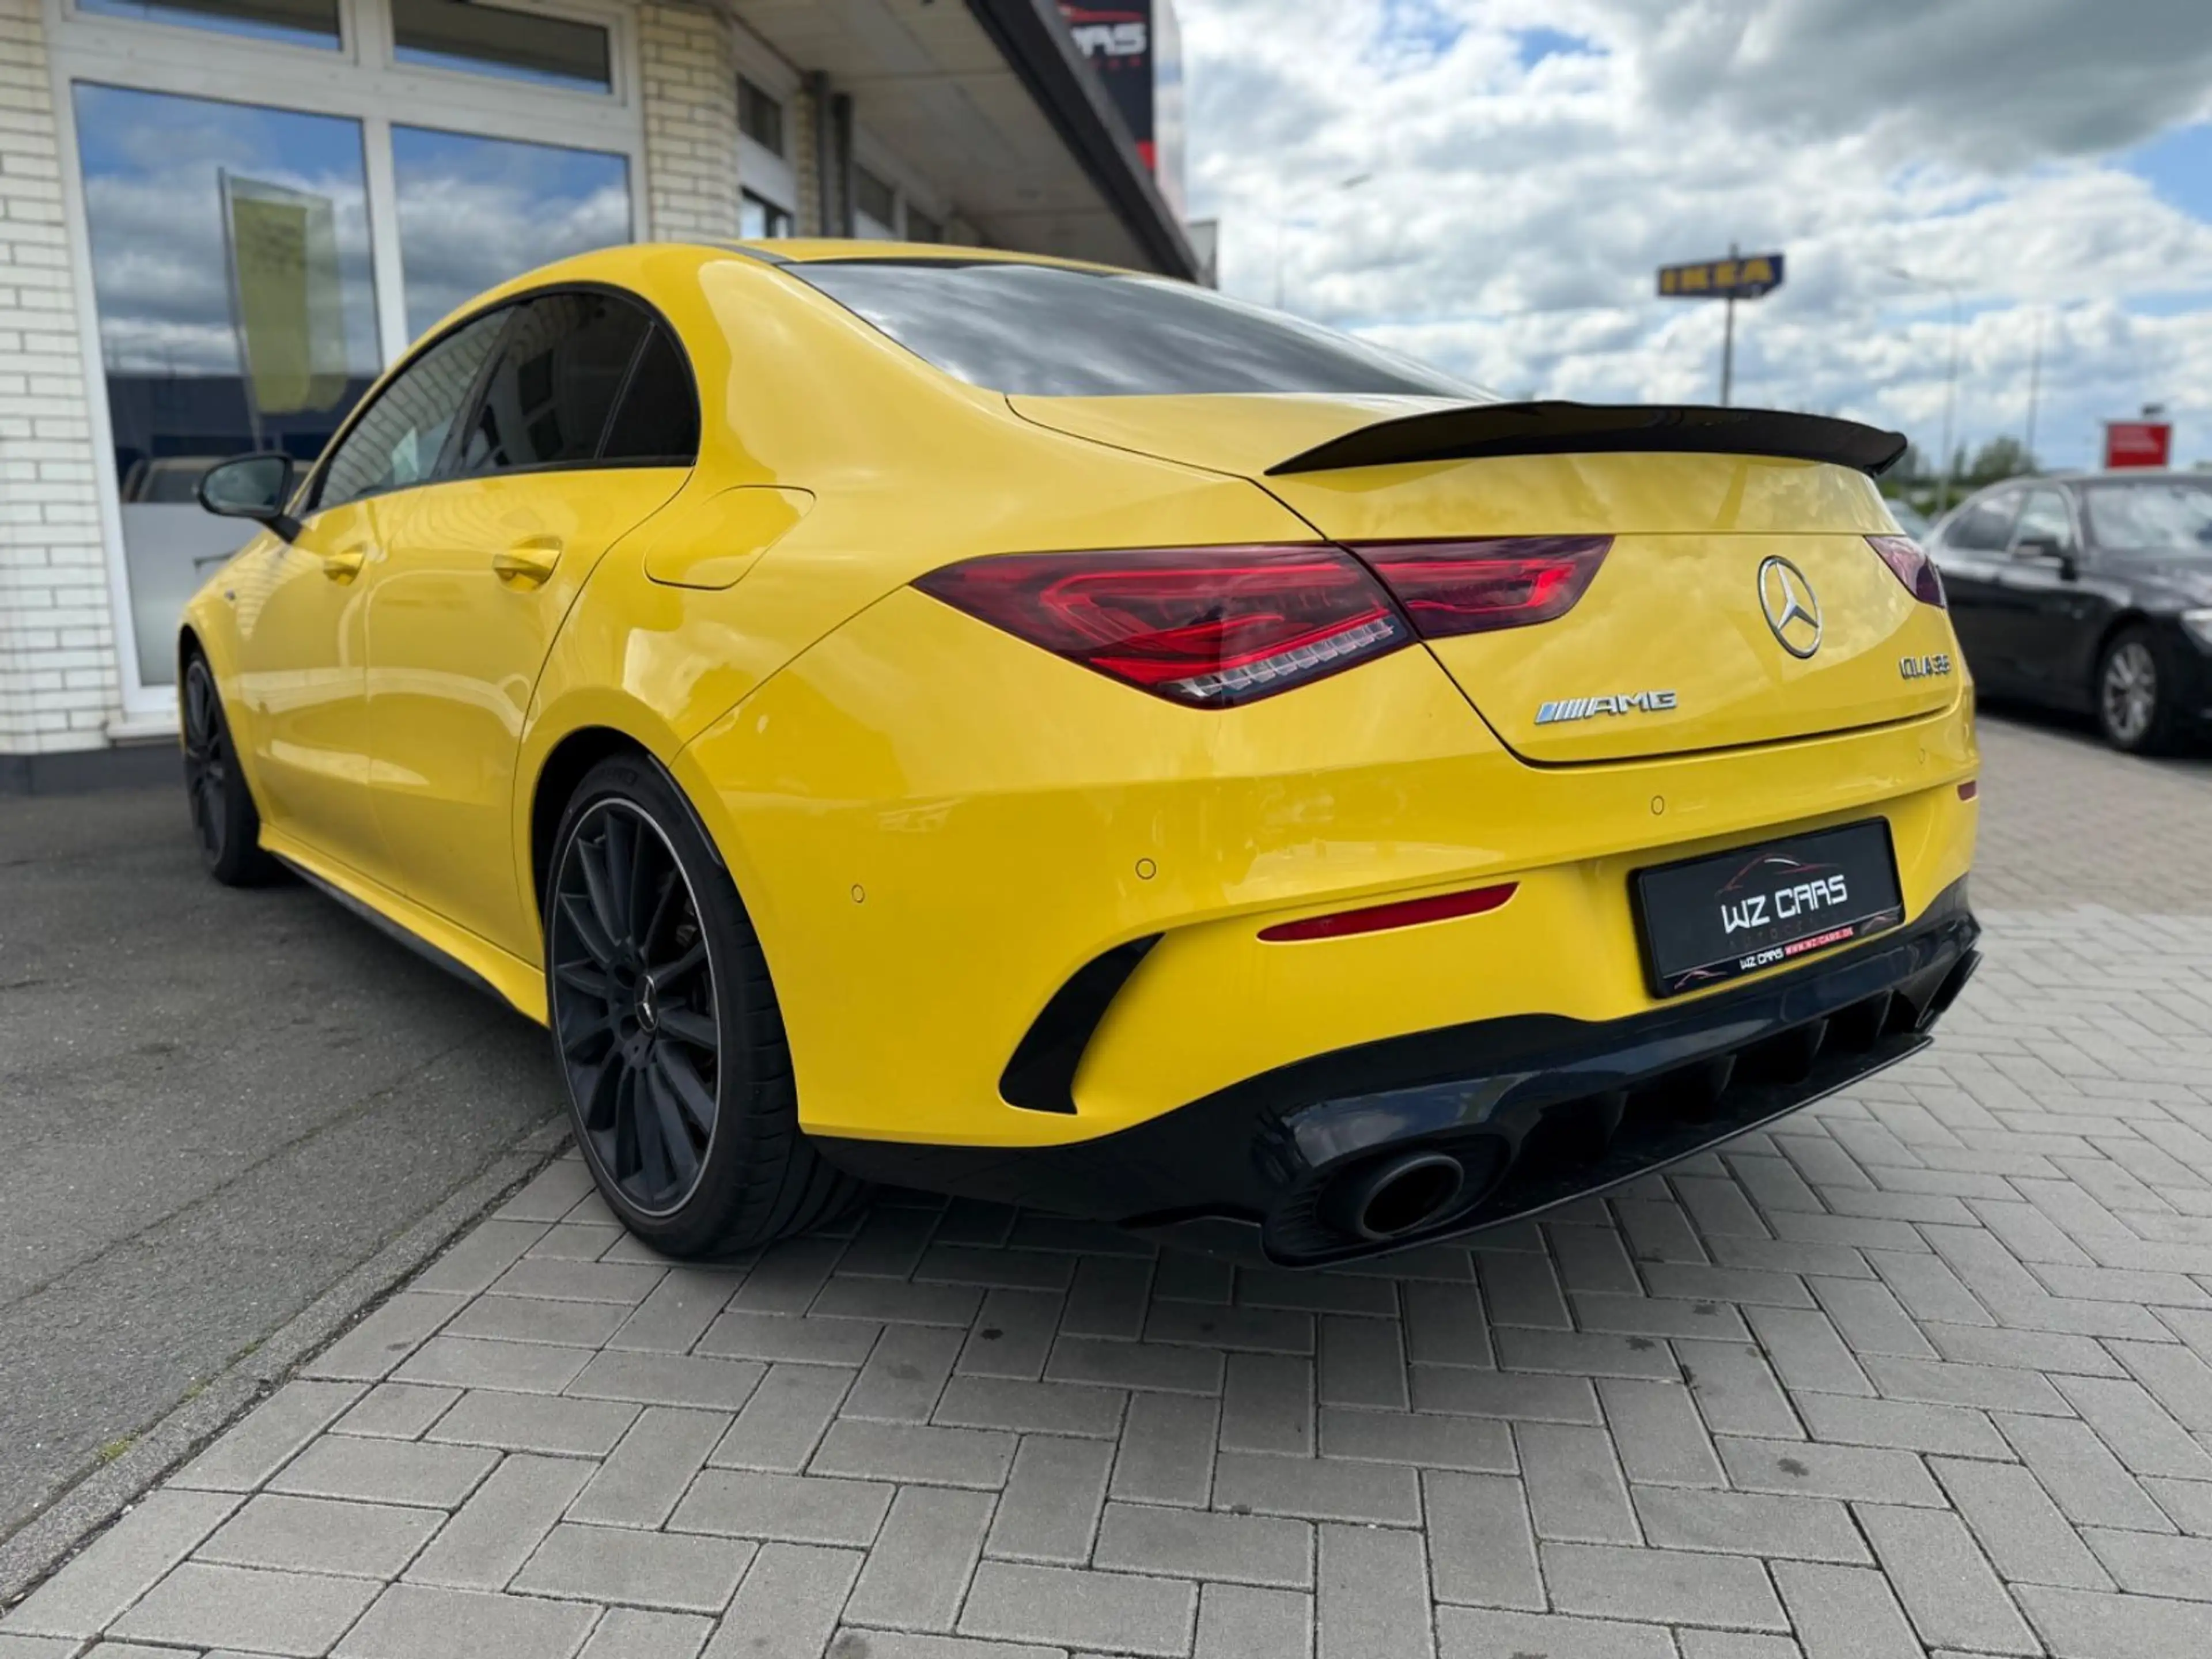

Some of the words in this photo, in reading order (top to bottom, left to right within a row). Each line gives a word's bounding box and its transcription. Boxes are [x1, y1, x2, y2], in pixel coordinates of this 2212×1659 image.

[1721, 895, 1770, 934] WZ
[1775, 874, 1847, 918] CARS
[1740, 955, 1758, 970] WZ
[1758, 948, 1784, 965] CARS
